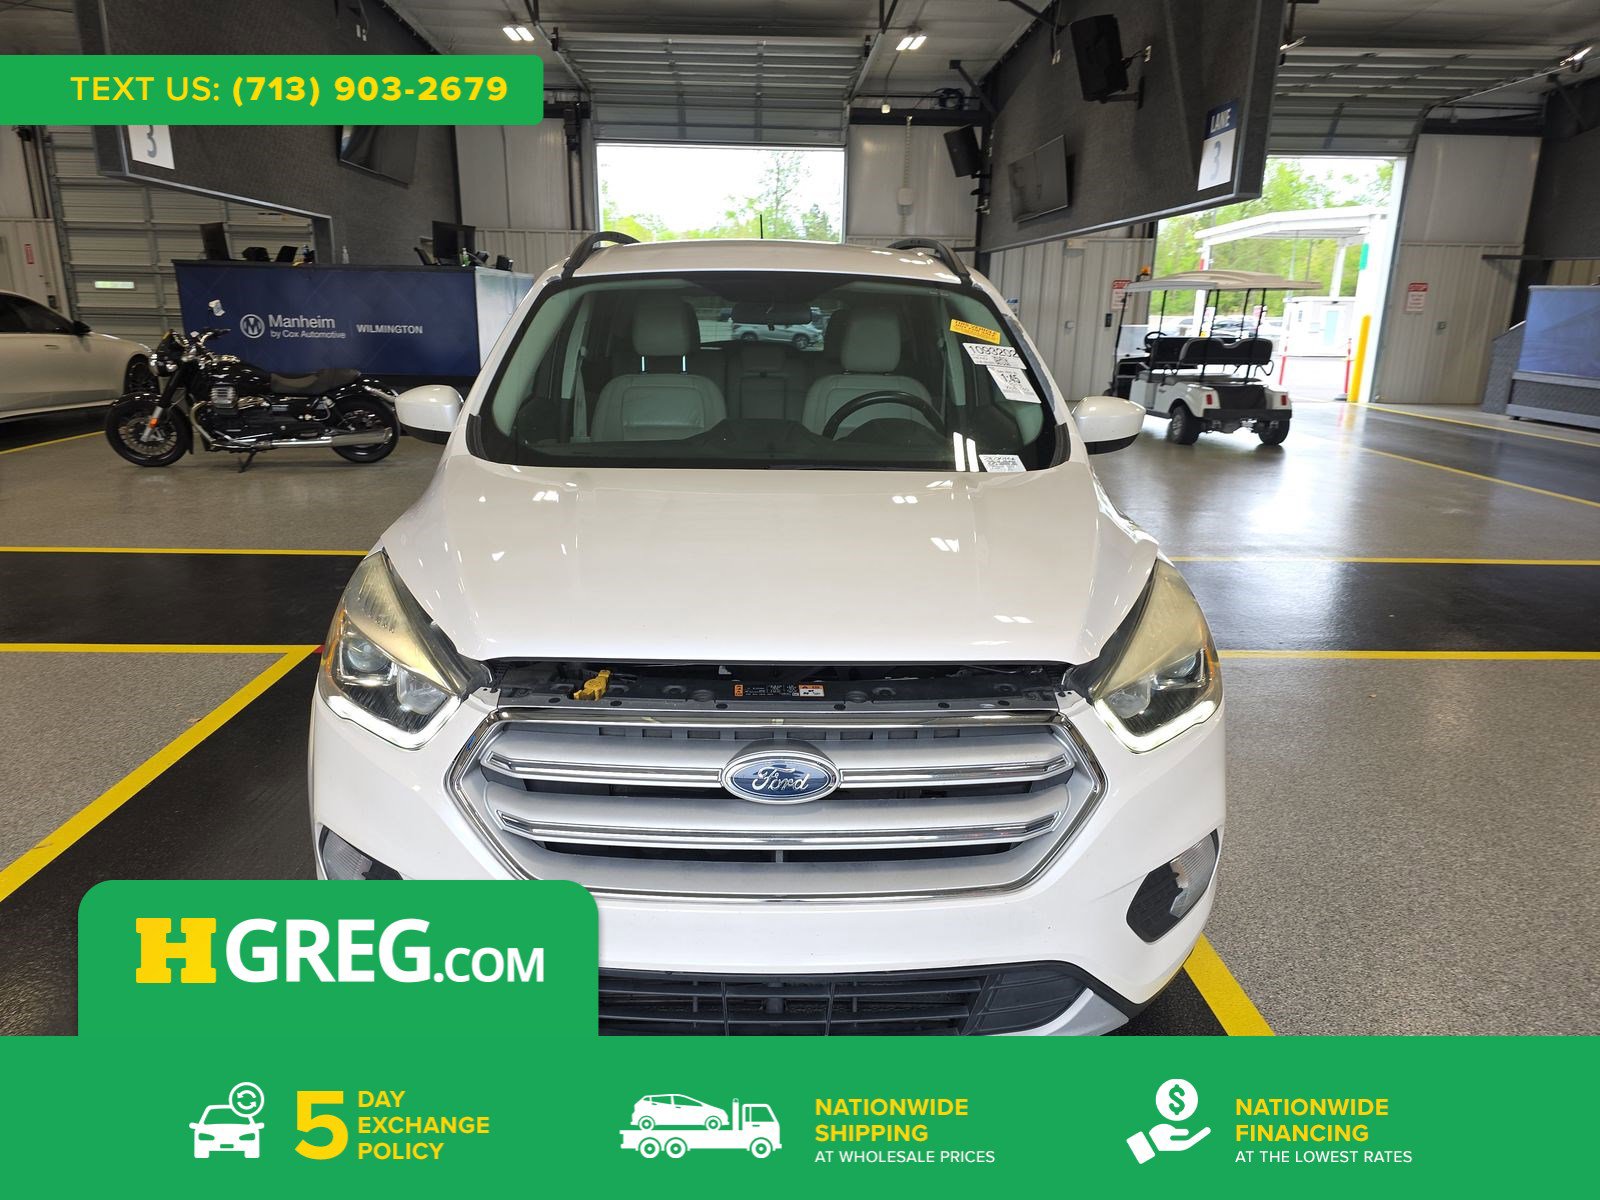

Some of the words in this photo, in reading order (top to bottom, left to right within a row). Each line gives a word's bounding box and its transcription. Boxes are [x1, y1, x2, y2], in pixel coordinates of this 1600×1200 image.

[1210, 140, 1222, 181] 3
[268, 314, 336, 329] Manheim
[356, 324, 423, 334] WILMINGTON
[271, 330, 281, 339] by
[282, 330, 299, 338] Cox
[301, 330, 346, 339] Automotive
[751, 766, 810, 790] Ford
